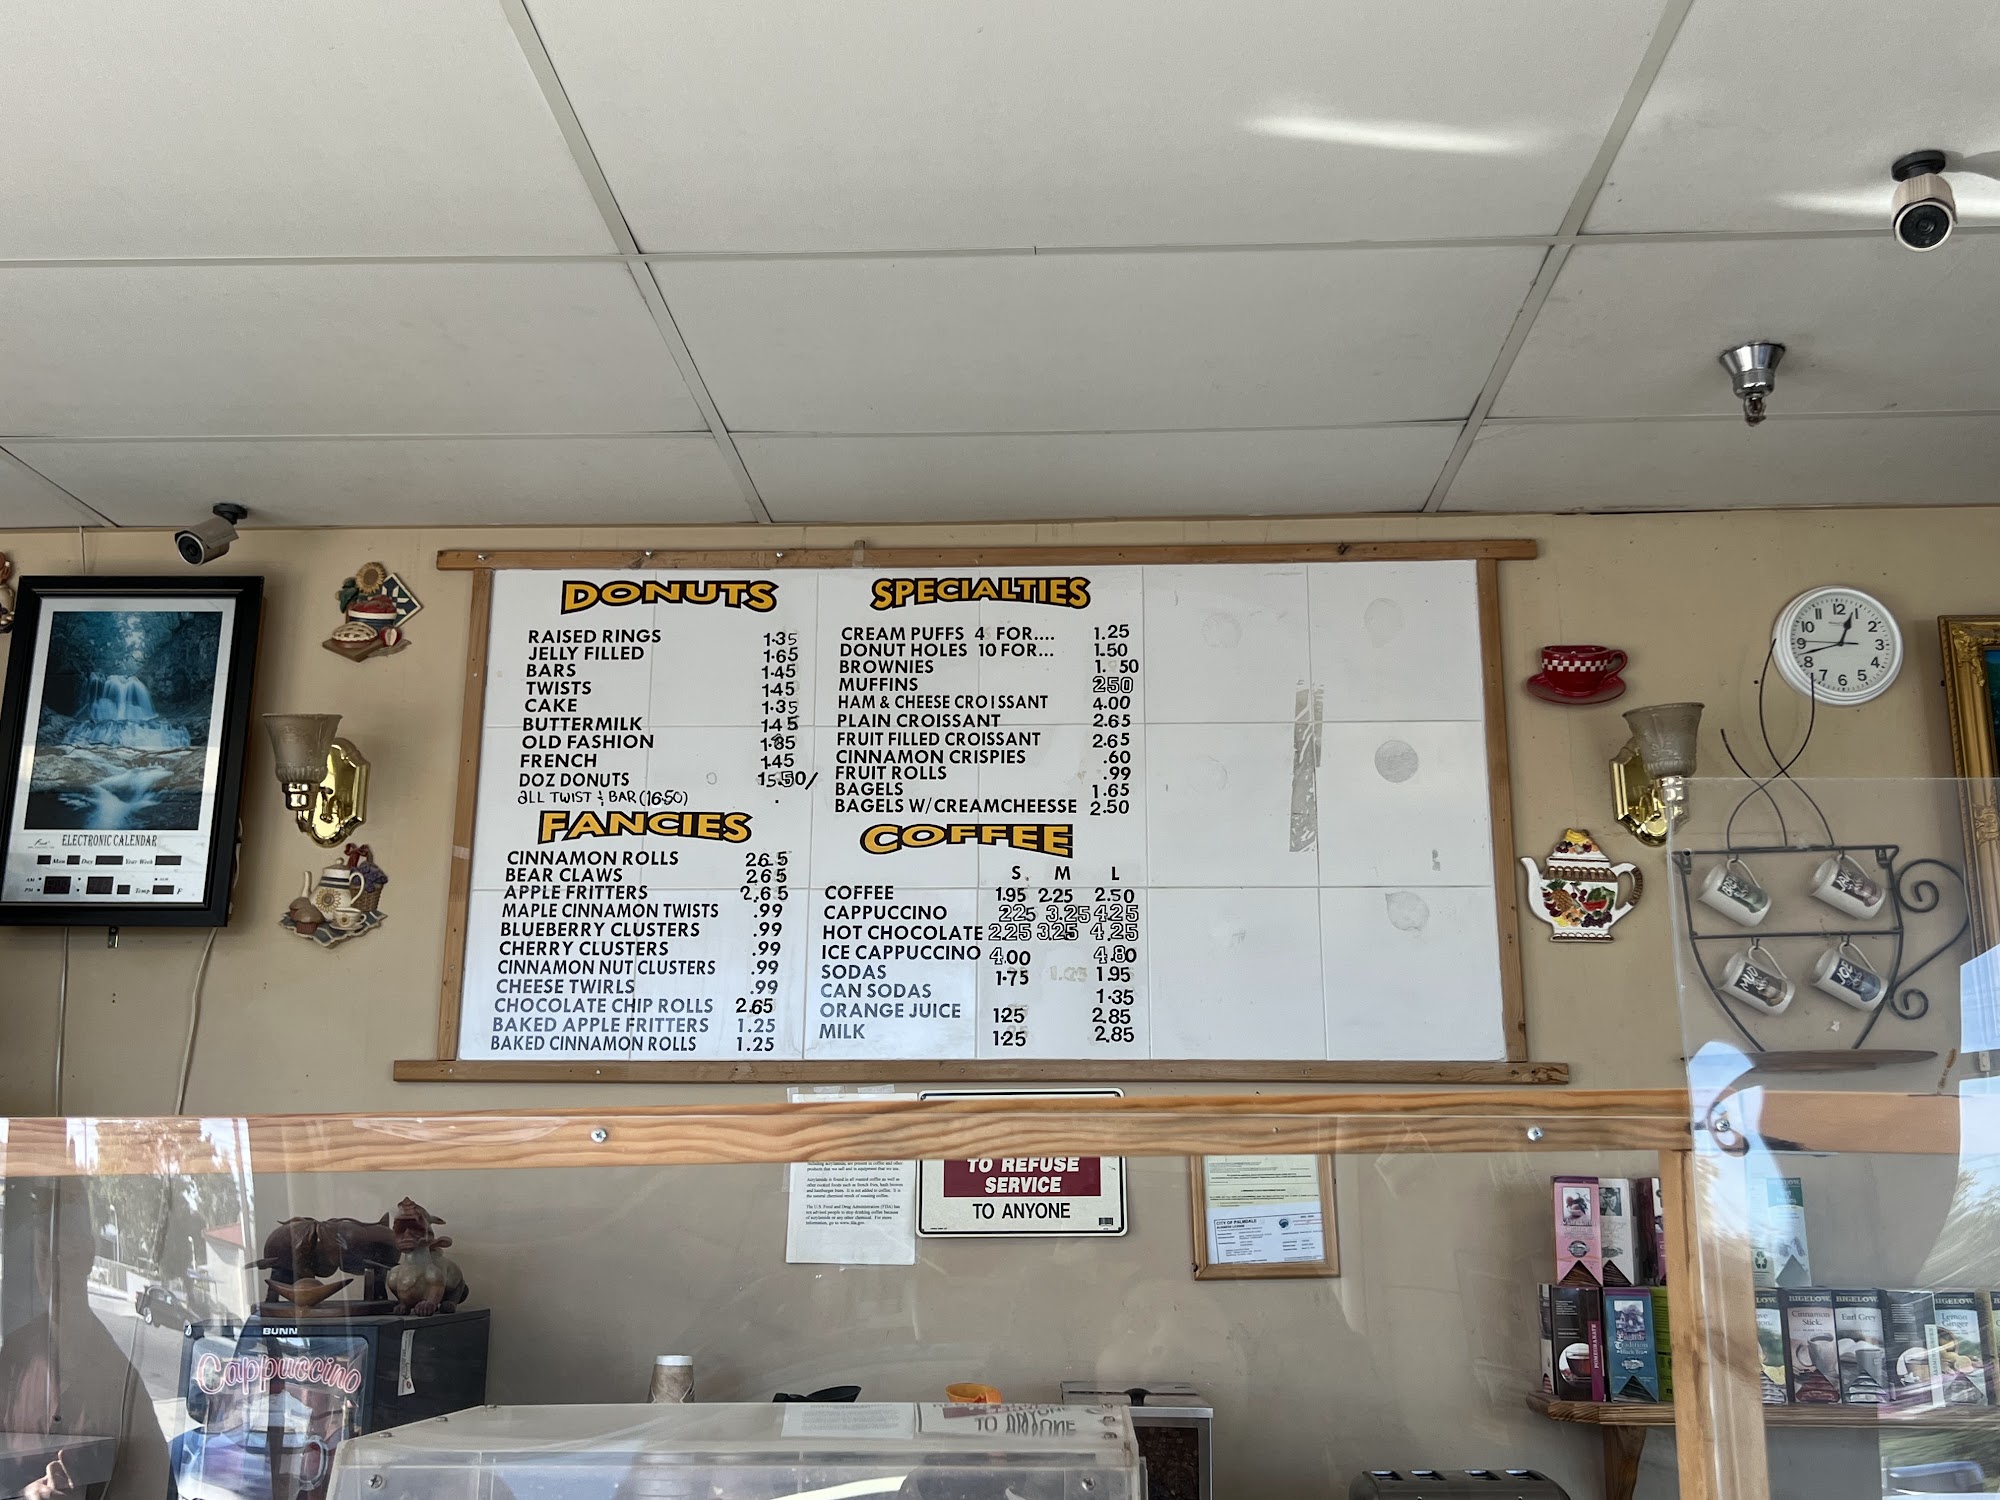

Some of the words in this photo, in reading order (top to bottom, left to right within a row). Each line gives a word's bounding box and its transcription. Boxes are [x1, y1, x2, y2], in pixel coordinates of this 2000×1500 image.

[561, 580, 779, 614] DONUTS
[870, 577, 1091, 611] SPECIALTIES
[1815, 608, 1822, 620] 11
[1833, 604, 1846, 615] 12
[1855, 608, 1858, 619] 1
[841, 627, 905, 640] CREAM
[911, 627, 964, 640] PUFFS
[974, 627, 985, 640] 4
[1094, 625, 1129, 640] 1.25
[1801, 621, 1814, 632] 10
[1868, 621, 1877, 632] 2
[529, 630, 596, 643] RAISED
[603, 630, 661, 643] RINGS
[1797, 638, 1806, 649] 9
[840, 644, 906, 657] DONUT
[911, 644, 967, 657] HOLES
[978, 644, 996, 657] 10
[1875, 639, 1884, 650] 3
[529, 648, 578, 660] JELLY
[584, 647, 644, 660] FILLED
[839, 660, 934, 673] BROWNIES
[1804, 656, 1813, 668] 8
[1871, 657, 1880, 668] 4
[526, 664, 576, 677] BARS
[1819, 670, 1828, 681] 7
[1858, 670, 1867, 681] 5
[839, 678, 918, 691] MUFFINS
[1838, 674, 1847, 686] 6
[526, 681, 592, 695] TWISTS
[525, 699, 577, 712] CAKE
[838, 696, 875, 709] HAM
[895, 695, 950, 709] CHEESE
[954, 695, 1048, 708] CROISSANT
[1093, 697, 1130, 710] 4.00
[523, 717, 642, 731] BUTTERMILK
[837, 714, 890, 727] PLAIN
[897, 714, 1000, 727] CROISSANT
[1093, 714, 1130, 728] 2.65
[522, 735, 561, 749] OLD
[567, 735, 653, 748] FASHION
[837, 733, 883, 746] FRUIT
[888, 733, 940, 746] FILLED
[945, 733, 1041, 746] CROISSANT
[1093, 733, 1129, 748] 2.65
[520, 754, 596, 768] FRENCH
[836, 750, 944, 764] CINNAMON
[949, 750, 1026, 763] CRISPIES
[1104, 751, 1130, 764] .60
[519, 773, 555, 787] DOZ
[560, 773, 629, 787] DONUTS
[836, 767, 887, 780] FRUIT
[892, 766, 947, 779] ROLLS
[1104, 767, 1130, 781] .99
[552, 791, 592, 803] TWIST
[609, 790, 636, 803] BAR
[835, 783, 903, 796] BAGELS
[1092, 784, 1129, 798] 1.65
[835, 799, 903, 813] BAGELS
[1090, 801, 1129, 816] 2.50
[538, 810, 753, 844] FANCIES
[62, 835, 112, 846] ELECTRONIC
[113, 835, 157, 846] CALENDAR
[860, 824, 1073, 858] COFFEE
[507, 851, 618, 865] CINNAMON
[622, 851, 678, 865] ROLLS
[505, 868, 552, 882] BEAR
[559, 868, 622, 882] CLAWS
[1055, 866, 1071, 880] M
[1111, 867, 1119, 880] L
[504, 886, 562, 899] APPLE
[566, 886, 648, 899] FRITTERS
[825, 886, 894, 899] COFFEE
[1095, 887, 1134, 903] 2.50
[502, 904, 557, 918] MAPLE
[562, 904, 658, 918] CINNAMON
[663, 903, 719, 917] TWISTS
[754, 904, 782, 918] .99
[824, 906, 947, 919] CAPPUCCINO
[500, 923, 605, 937] BLUEBERRY
[611, 923, 700, 936] CLUSTERS
[753, 922, 782, 937] .99
[823, 926, 862, 940] HOT
[868, 926, 983, 940] CHOCOLATE
[499, 941, 574, 956] CHERRY
[579, 942, 668, 956] CLUSTERS
[752, 941, 781, 956] .99
[822, 946, 850, 959] ICE
[856, 946, 980, 960] CAPPUCCINO
[498, 960, 594, 975] CINNAMON
[600, 960, 633, 975] NUT
[638, 960, 716, 975] CLUSTERS
[751, 961, 778, 975] .99
[821, 965, 886, 979] SODAS
[1835, 960, 1853, 985] JOE
[1739, 966, 1759, 992] MUD
[496, 980, 563, 993] CHEESE
[569, 980, 635, 993] TWIRLS
[750, 980, 778, 994] .99
[821, 984, 862, 998] CAN
[867, 984, 931, 998] SODAS
[494, 998, 606, 1013] CHOCOLATE
[612, 999, 653, 1013] CHIP
[658, 999, 713, 1013] ROLLS
[736, 998, 773, 1014] 2.65
[820, 1004, 903, 1018] ORANGE
[909, 1004, 960, 1018] JUICE
[1092, 1007, 1130, 1024] 2.85
[493, 1018, 556, 1032] BAKED
[562, 1018, 620, 1032] APPLE
[626, 1018, 709, 1032] FRITTERS
[737, 1019, 775, 1032] 1.25
[819, 1024, 865, 1039] MILK
[1094, 1027, 1134, 1043] 2.85
[491, 1036, 544, 1050] BAKED
[549, 1036, 643, 1051] CINNAMON
[649, 1037, 696, 1051] ROLLS
[737, 1037, 774, 1051] 1.25
[967, 1158, 993, 1173] TO
[1001, 1157, 1079, 1172] REFUSE
[985, 1177, 1062, 1193] SERVICE
[973, 1204, 994, 1219] TO
[1002, 1203, 1070, 1219] ANYONE
[1858, 1314, 1876, 1322] Grey
[1941, 1320, 1968, 1328] Ginger
[263, 1327, 298, 1335] BUNN
[1591, 1324, 1599, 1369] POMEGRANATE
[199, 1353, 362, 1395] Cappuccino
